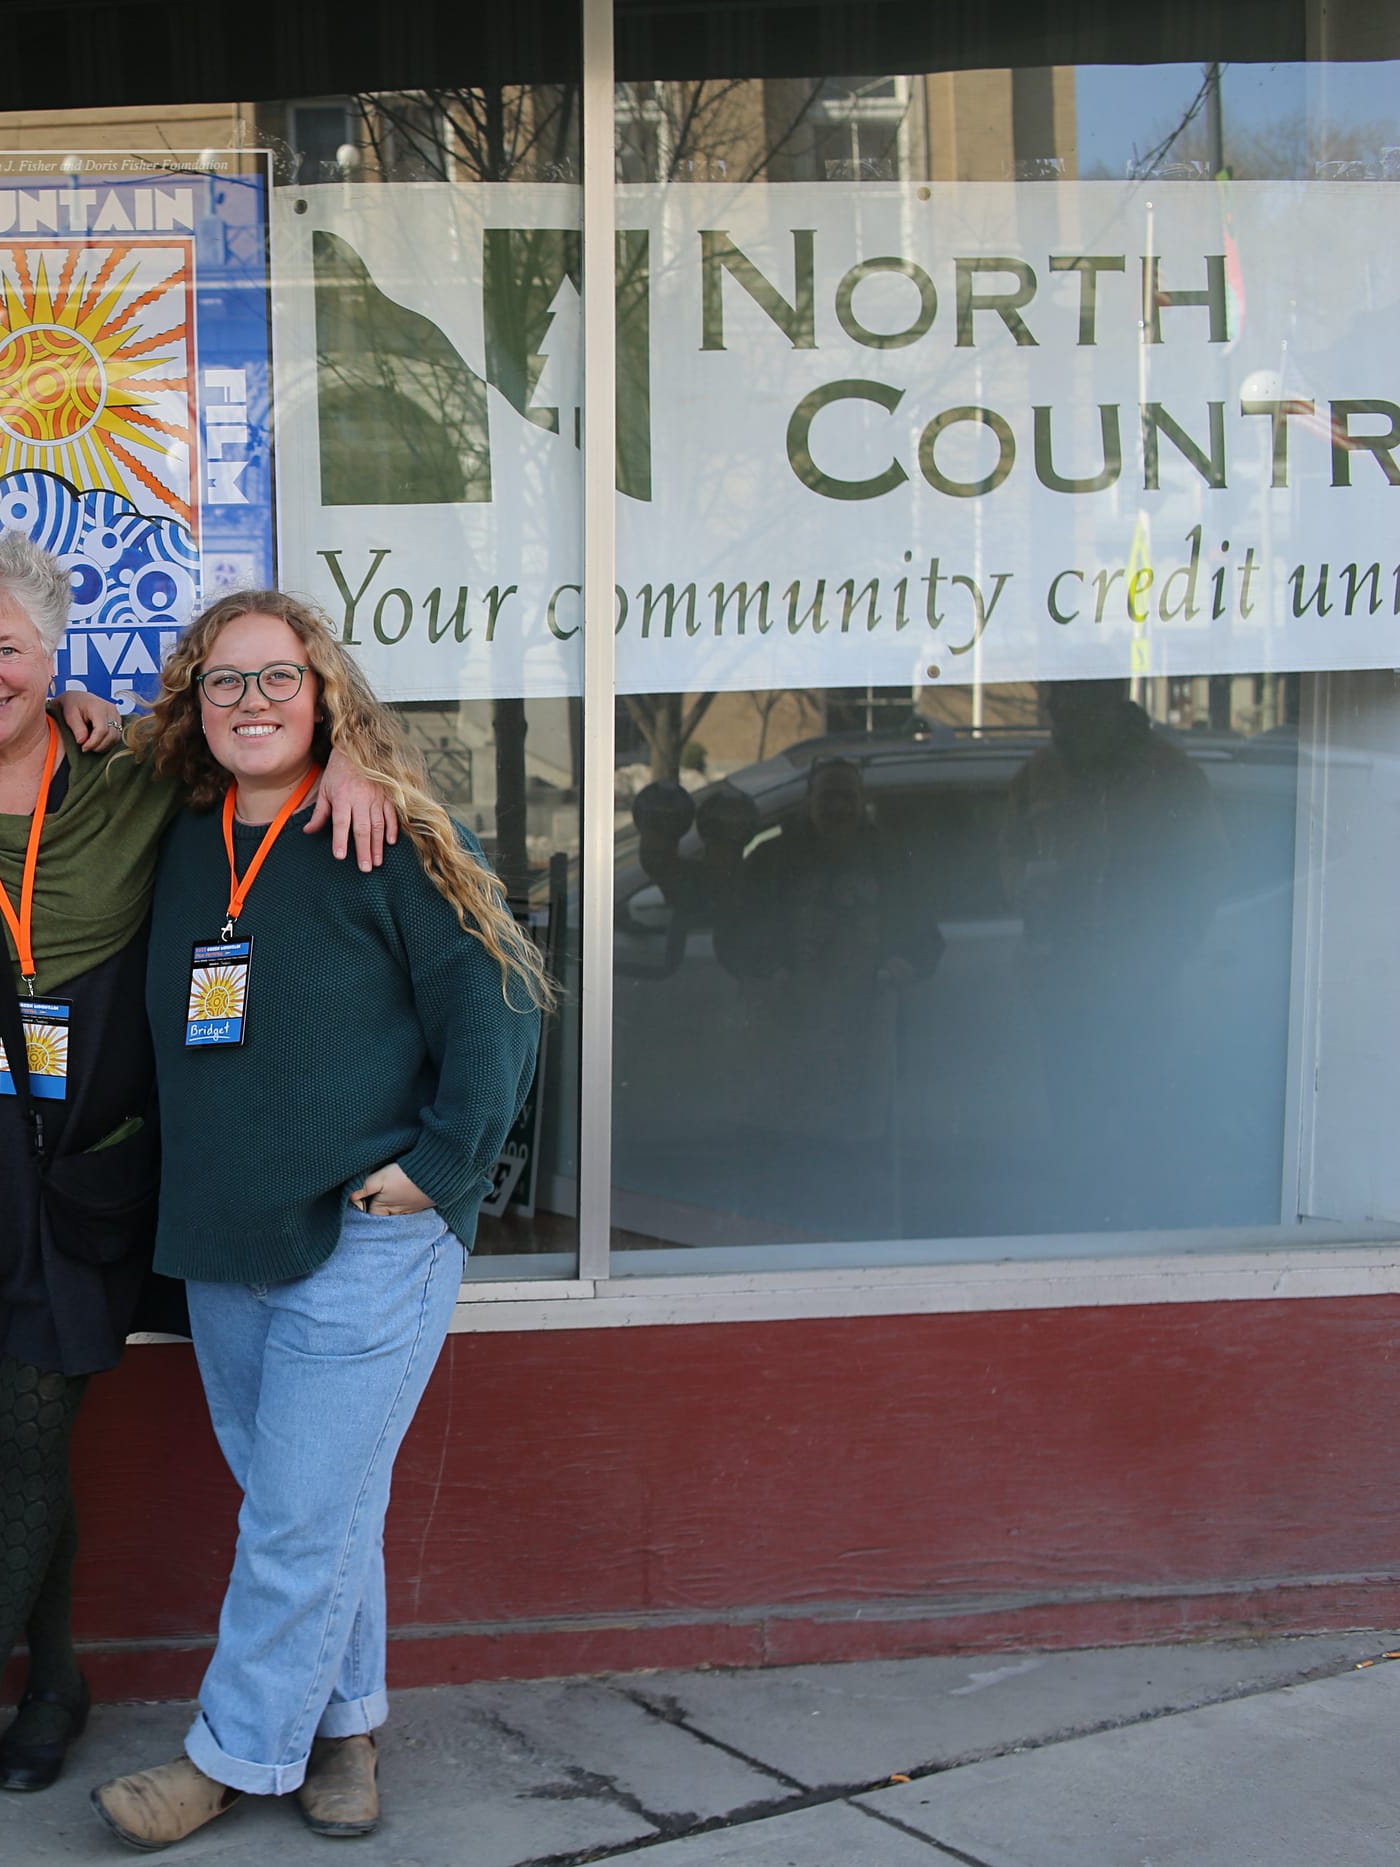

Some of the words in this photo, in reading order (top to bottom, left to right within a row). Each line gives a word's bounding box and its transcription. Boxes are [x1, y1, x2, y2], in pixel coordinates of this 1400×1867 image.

[4, 160, 15, 172] J.
[18, 159, 56, 172] Fisher
[60, 159, 81, 171] and
[85, 159, 117, 171] Doris
[121, 159, 158, 171] Fisher
[161, 159, 228, 171] Foundation
[698, 228, 1231, 351] NORTH
[205, 369, 250, 504] FILM
[316, 549, 517, 645] Your
[1047, 523, 1260, 624] credit
[190, 1022, 230, 1041] Bridget
